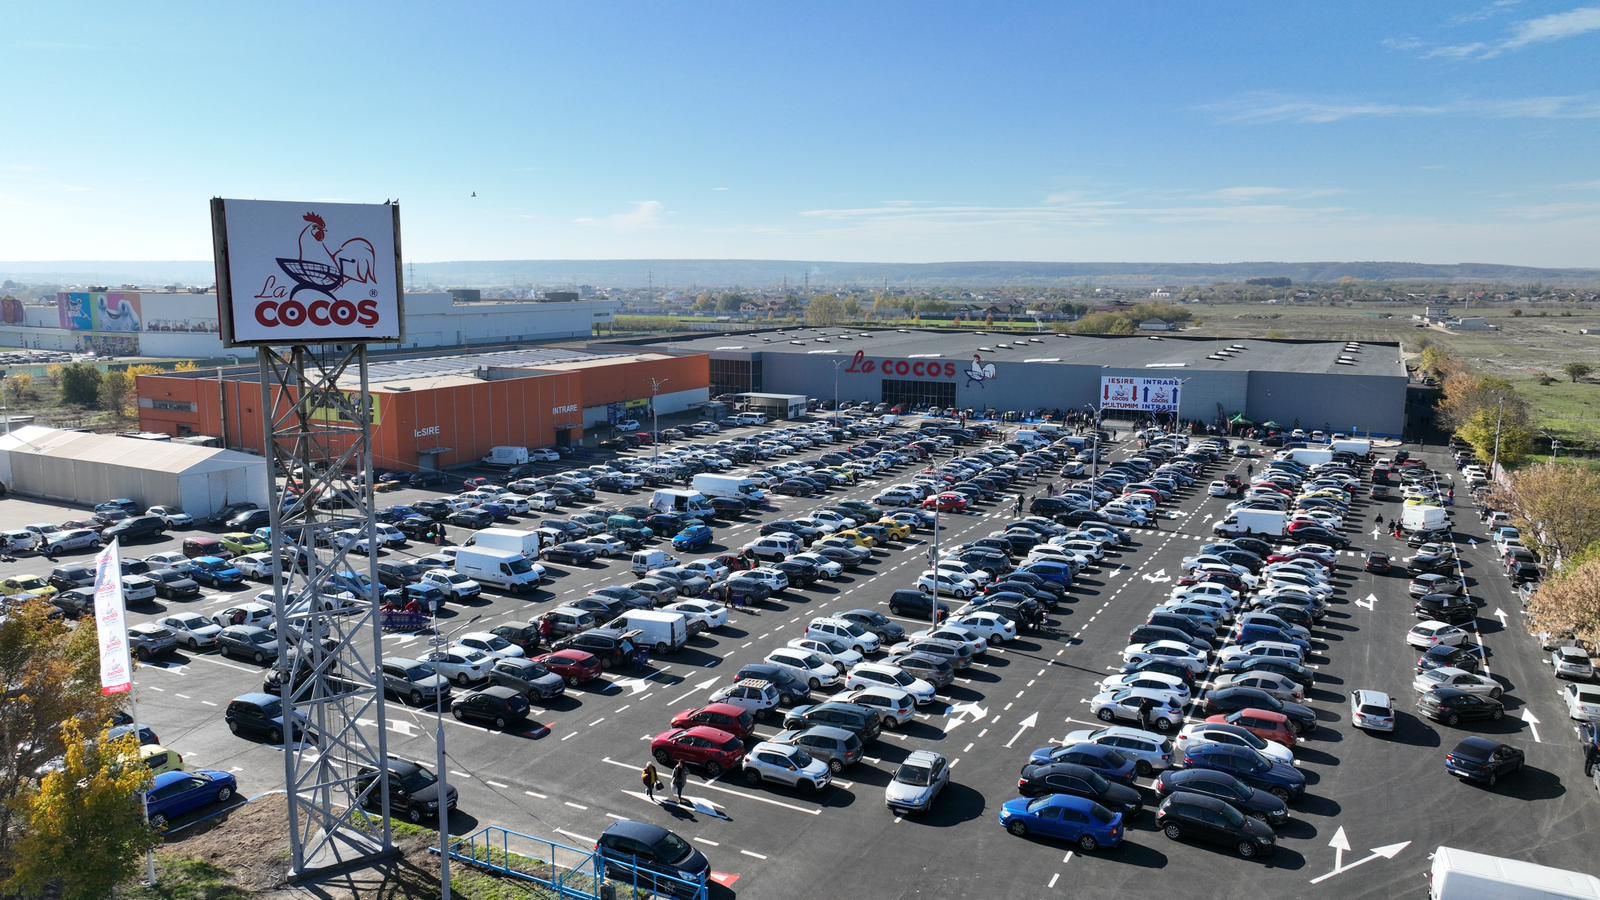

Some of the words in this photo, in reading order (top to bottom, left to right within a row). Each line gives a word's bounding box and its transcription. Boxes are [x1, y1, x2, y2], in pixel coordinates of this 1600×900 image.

[254, 275, 288, 298] La
[845, 350, 876, 374] La
[881, 359, 957, 377] COCOS
